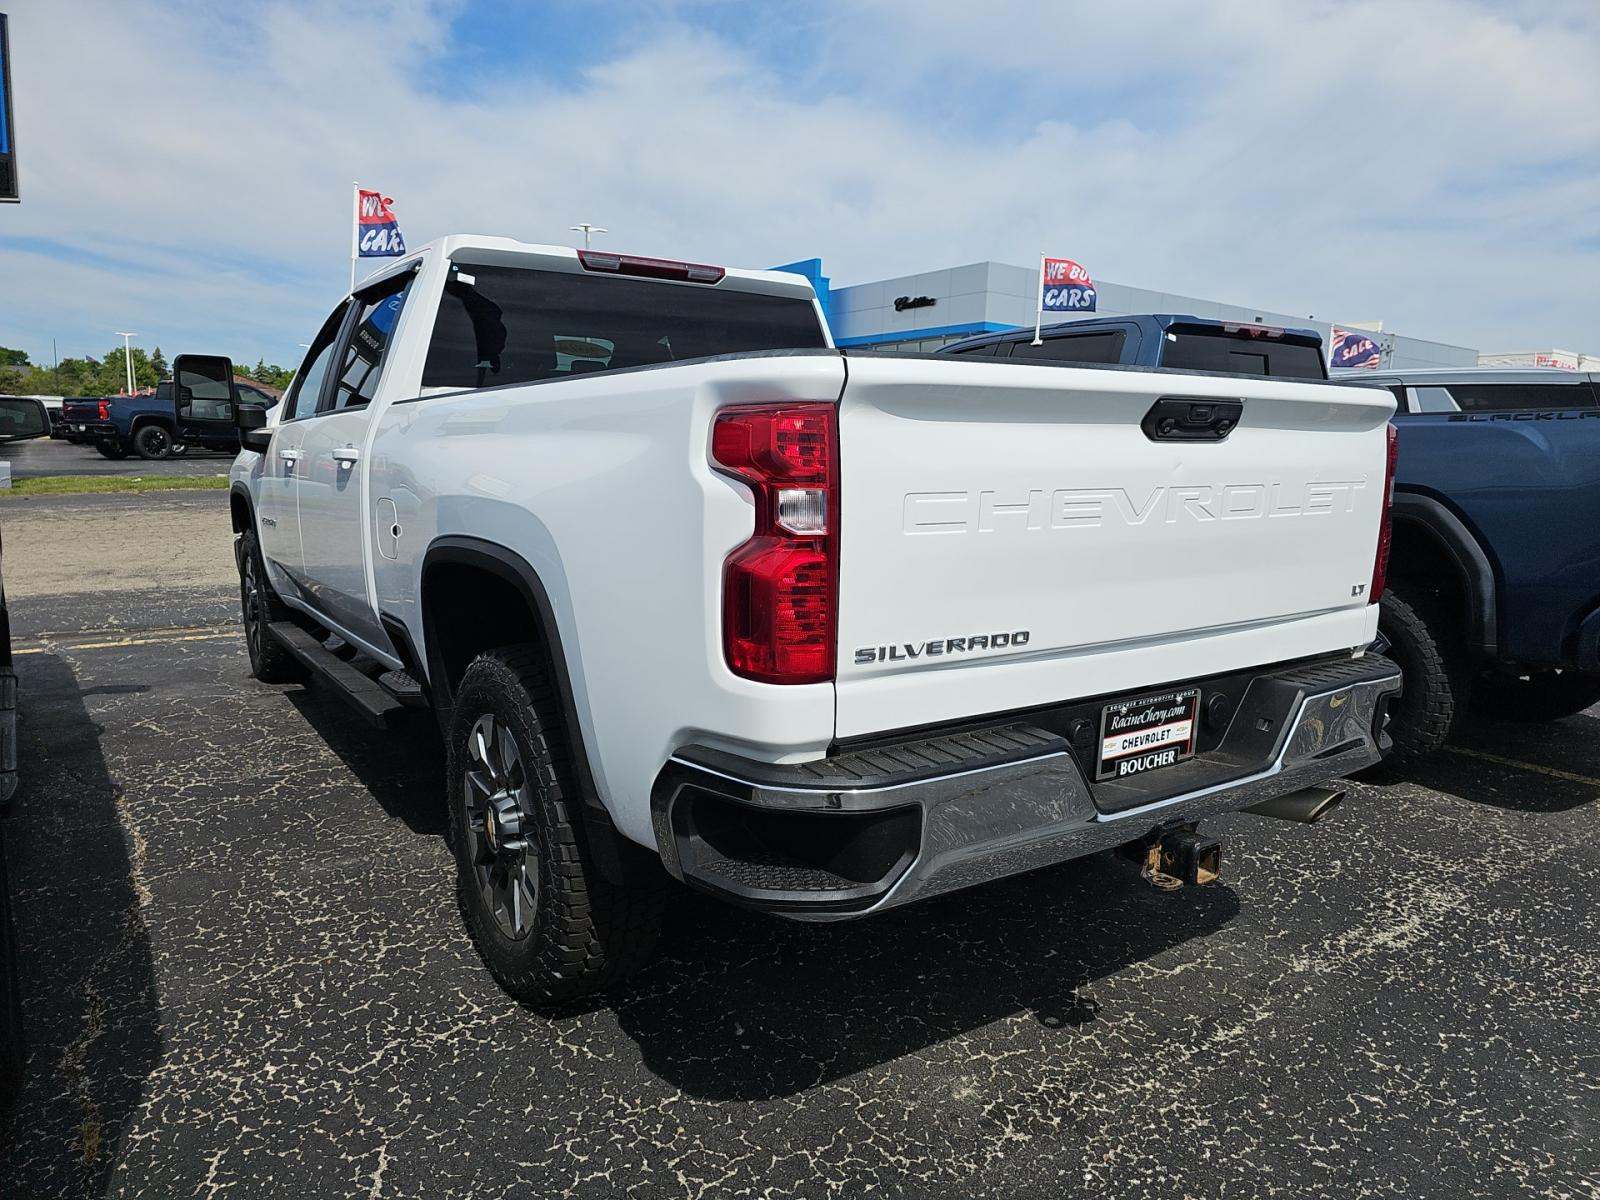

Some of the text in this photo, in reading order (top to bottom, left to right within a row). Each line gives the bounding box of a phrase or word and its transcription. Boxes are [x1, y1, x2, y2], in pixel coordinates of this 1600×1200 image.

[360, 229, 405, 252] CAR
[1047, 262, 1092, 284] WE BU
[1045, 288, 1095, 308] CARS
[1342, 339, 1373, 361] SALE
[902, 479, 1366, 536] CHEVROLET
[1351, 583, 1366, 596] LT
[854, 630, 1030, 665] SILVERADO
[1110, 706, 1186, 730] RacineChevy.com
[1122, 729, 1171, 750] CHEVROLET
[1120, 751, 1175, 776] BOUCHER
